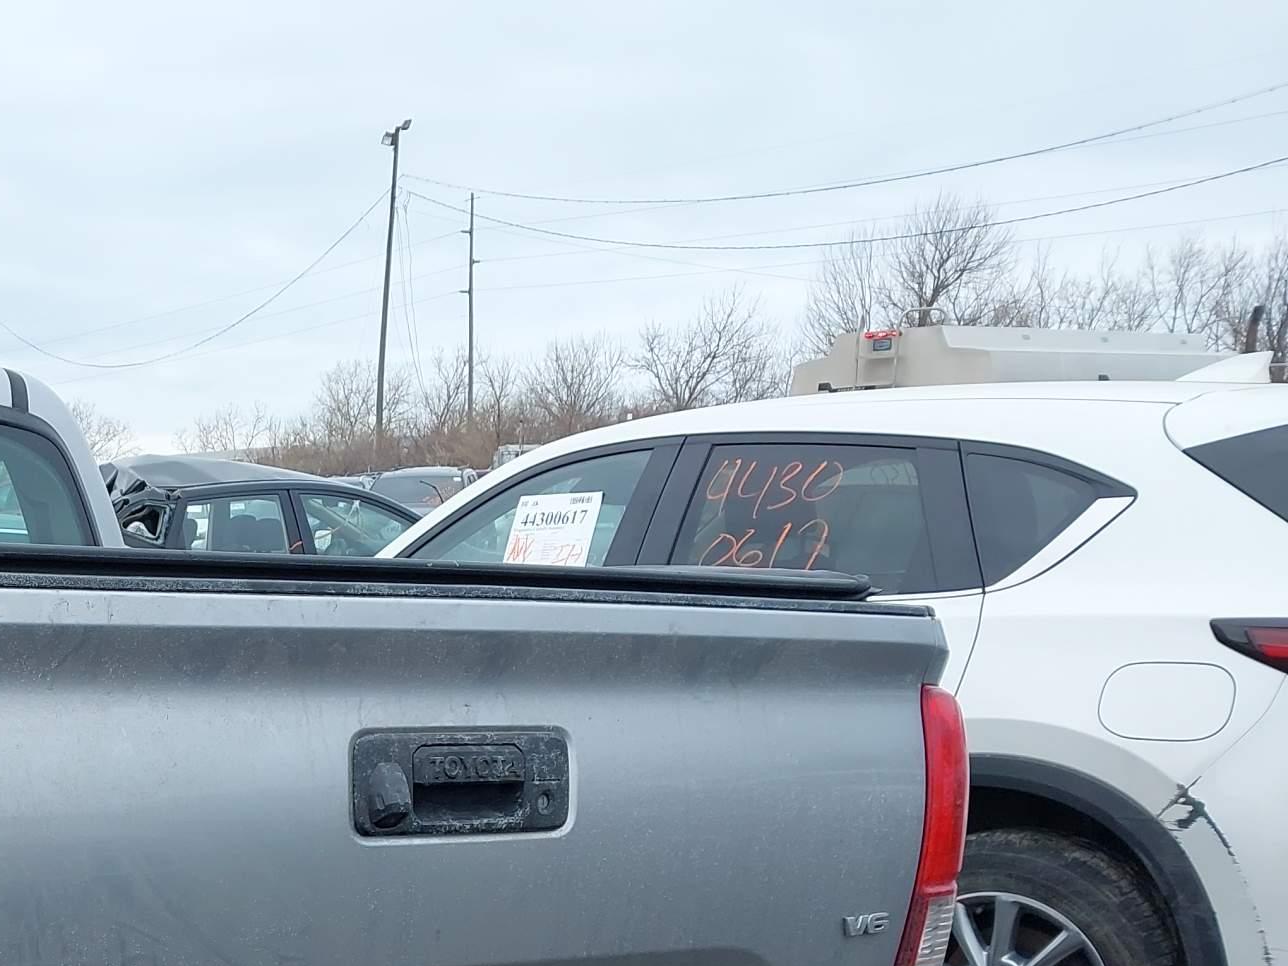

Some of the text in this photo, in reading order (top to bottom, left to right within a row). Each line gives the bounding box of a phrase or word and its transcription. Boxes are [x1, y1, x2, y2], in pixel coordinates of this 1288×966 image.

[706, 458, 844, 519] 4430
[520, 509, 588, 527] 44300617
[842, 911, 889, 936] V6
